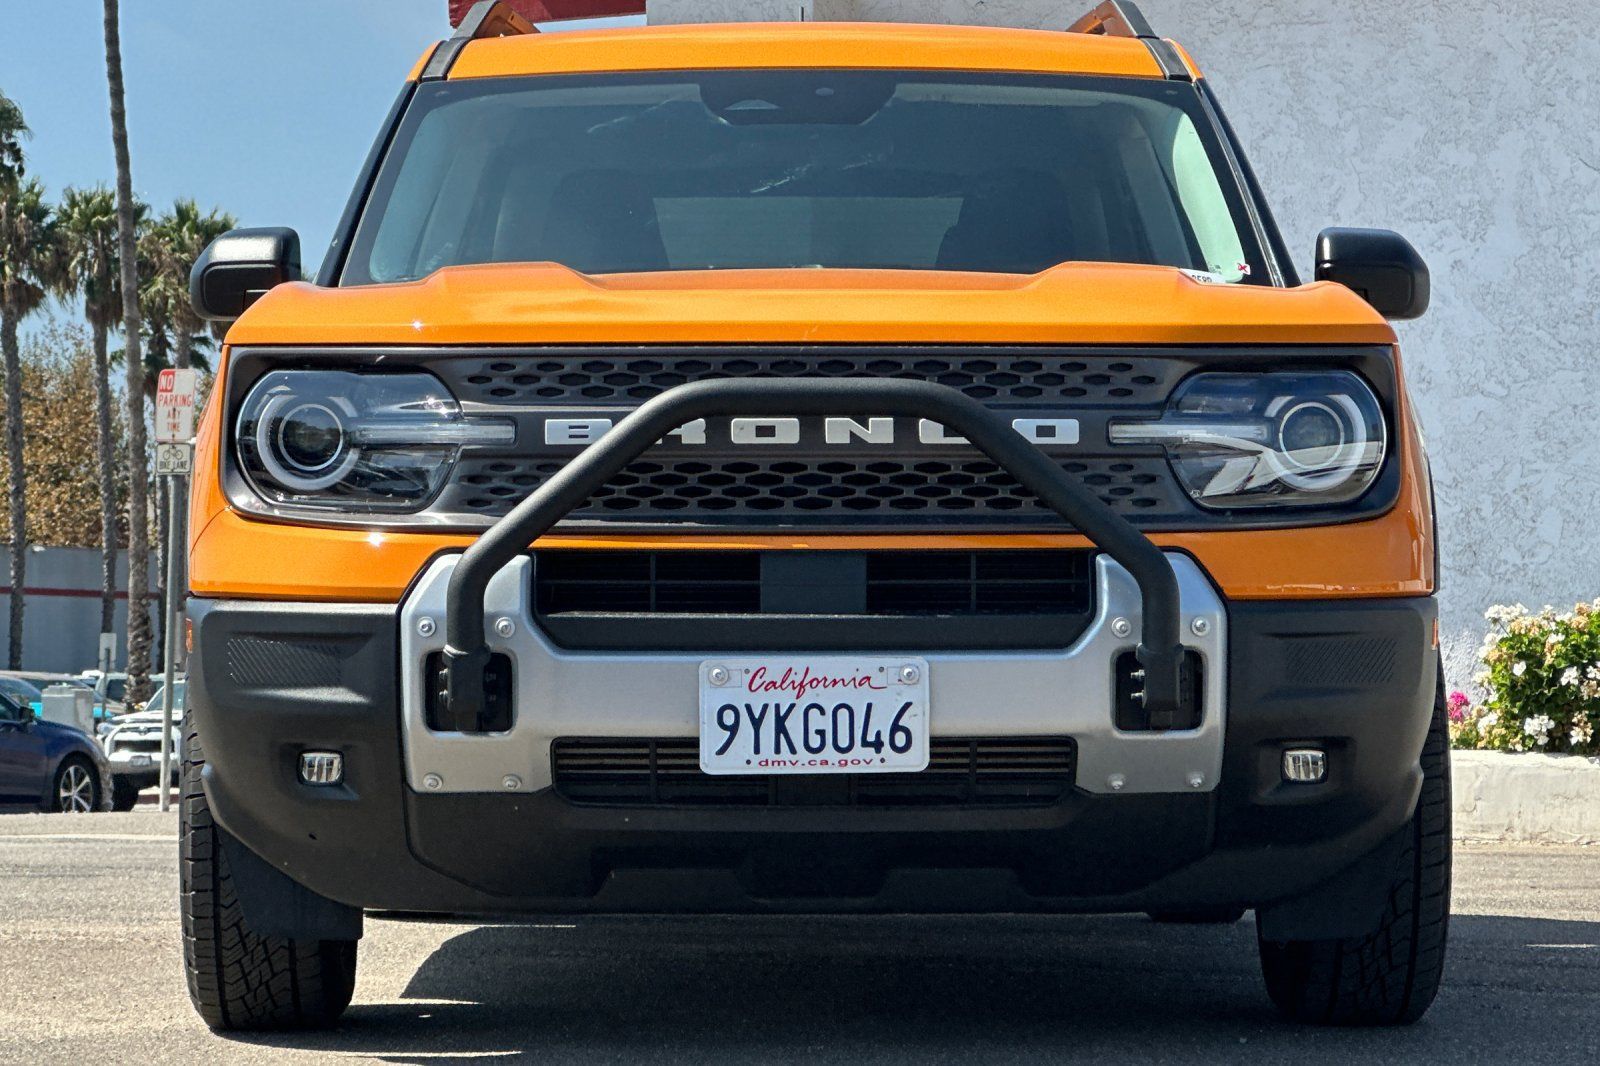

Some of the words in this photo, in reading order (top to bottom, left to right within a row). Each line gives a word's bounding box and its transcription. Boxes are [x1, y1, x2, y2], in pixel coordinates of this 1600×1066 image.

[159, 374, 174, 391] NO
[158, 395, 192, 407] PARKING
[167, 410, 181, 419] ANY
[167, 423, 181, 432] TIME
[159, 461, 171, 470] BIKE
[174, 461, 188, 470] LANE
[748, 665, 888, 699] California
[715, 701, 913, 755] 9YKG046
[758, 758, 873, 767] dmv.ca.gov
